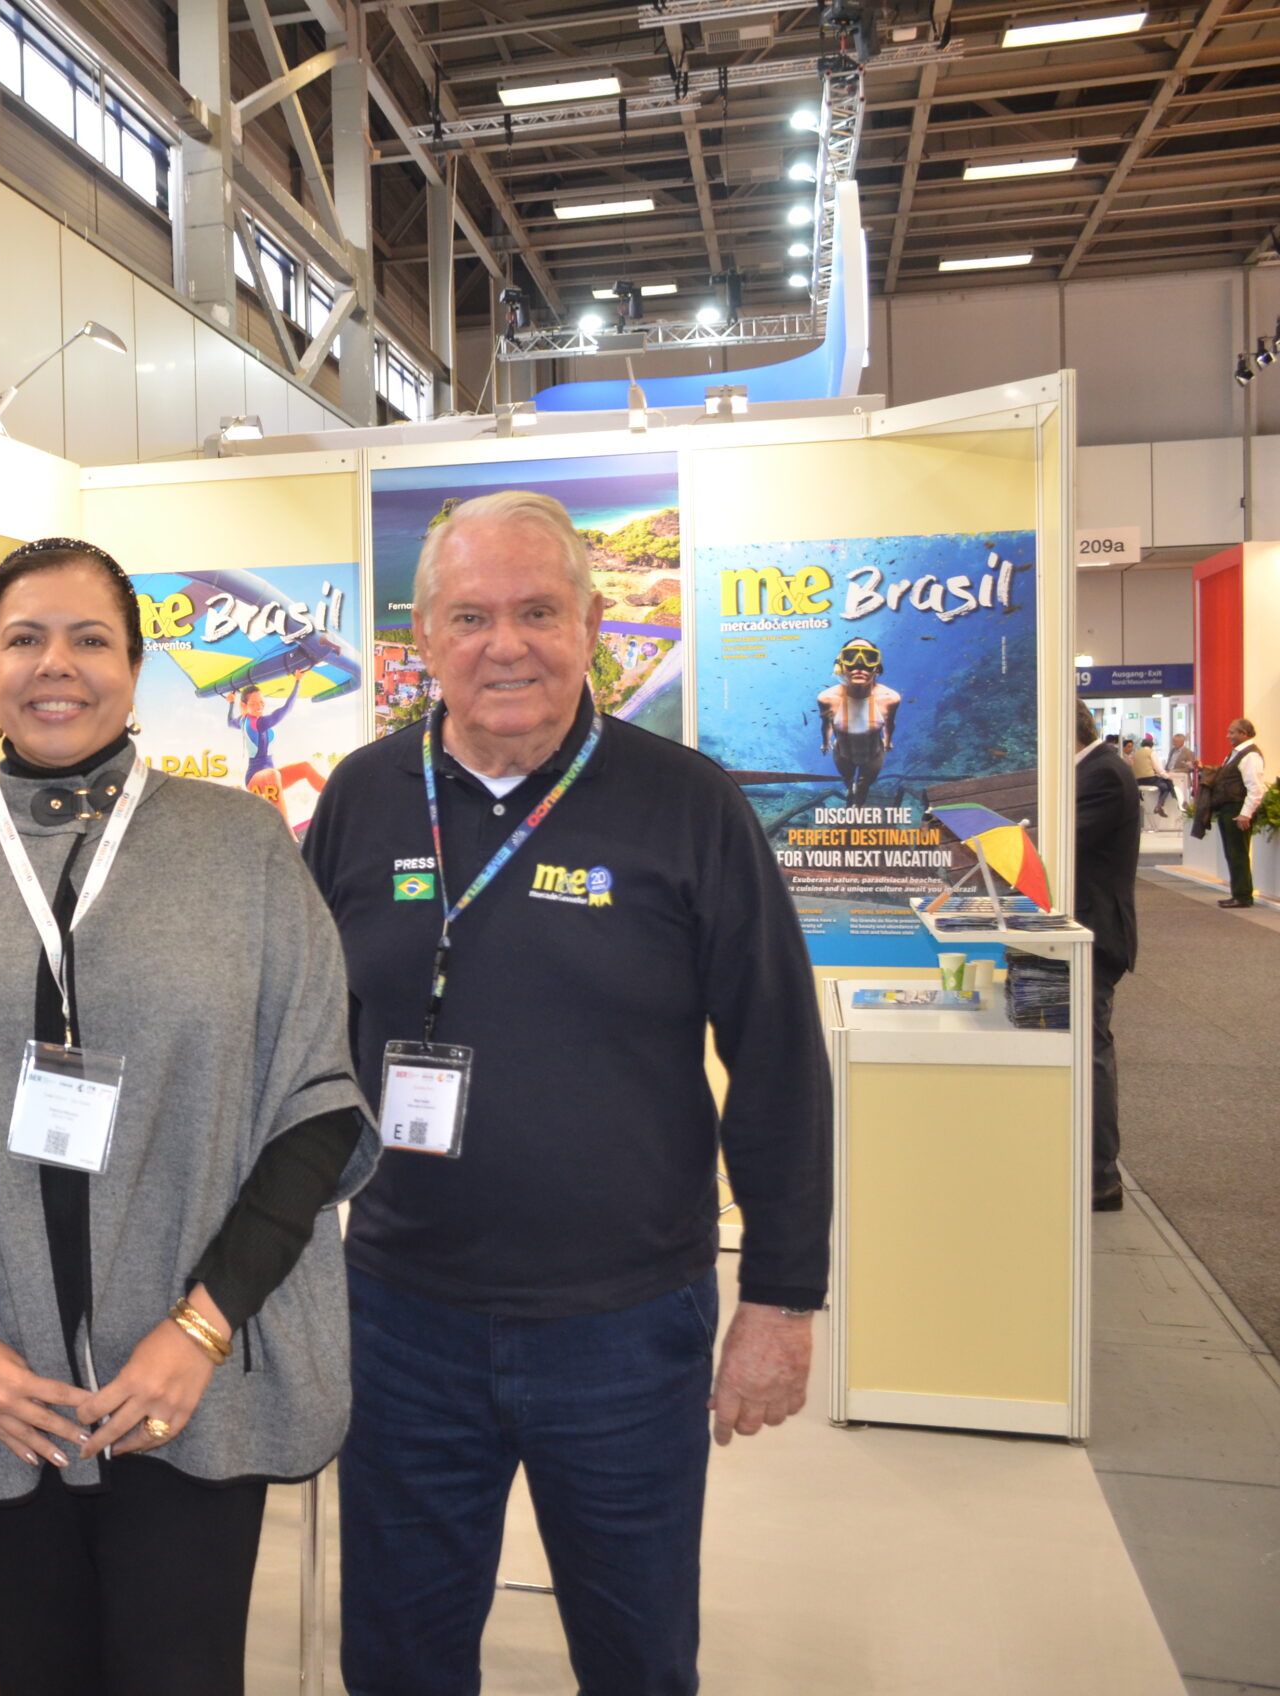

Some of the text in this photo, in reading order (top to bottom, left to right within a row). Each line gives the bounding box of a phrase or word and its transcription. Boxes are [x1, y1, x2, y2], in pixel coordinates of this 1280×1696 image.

[1079, 538, 1126, 554] 209a
[720, 551, 1013, 622] m&e Brasil
[200, 579, 345, 644] Brasil
[720, 617, 830, 632] mercado&eventos
[1112, 669, 1162, 679] Ausgang Exit
[162, 749, 228, 777] PAÍS
[527, 732, 600, 828] PERNAMBUCO
[814, 807, 912, 824] DISCOVER THE
[788, 828, 940, 846] PERFECT DESTINATION
[393, 857, 436, 871] PRESS
[776, 850, 952, 867] FOR YOUR NEXT VACATION
[590, 871, 607, 886] 20
[846, 885, 873, 893] unique
[874, 885, 903, 893] culture
[904, 885, 926, 893] await
[927, 886, 943, 894] you
[393, 1123, 403, 1140] E
